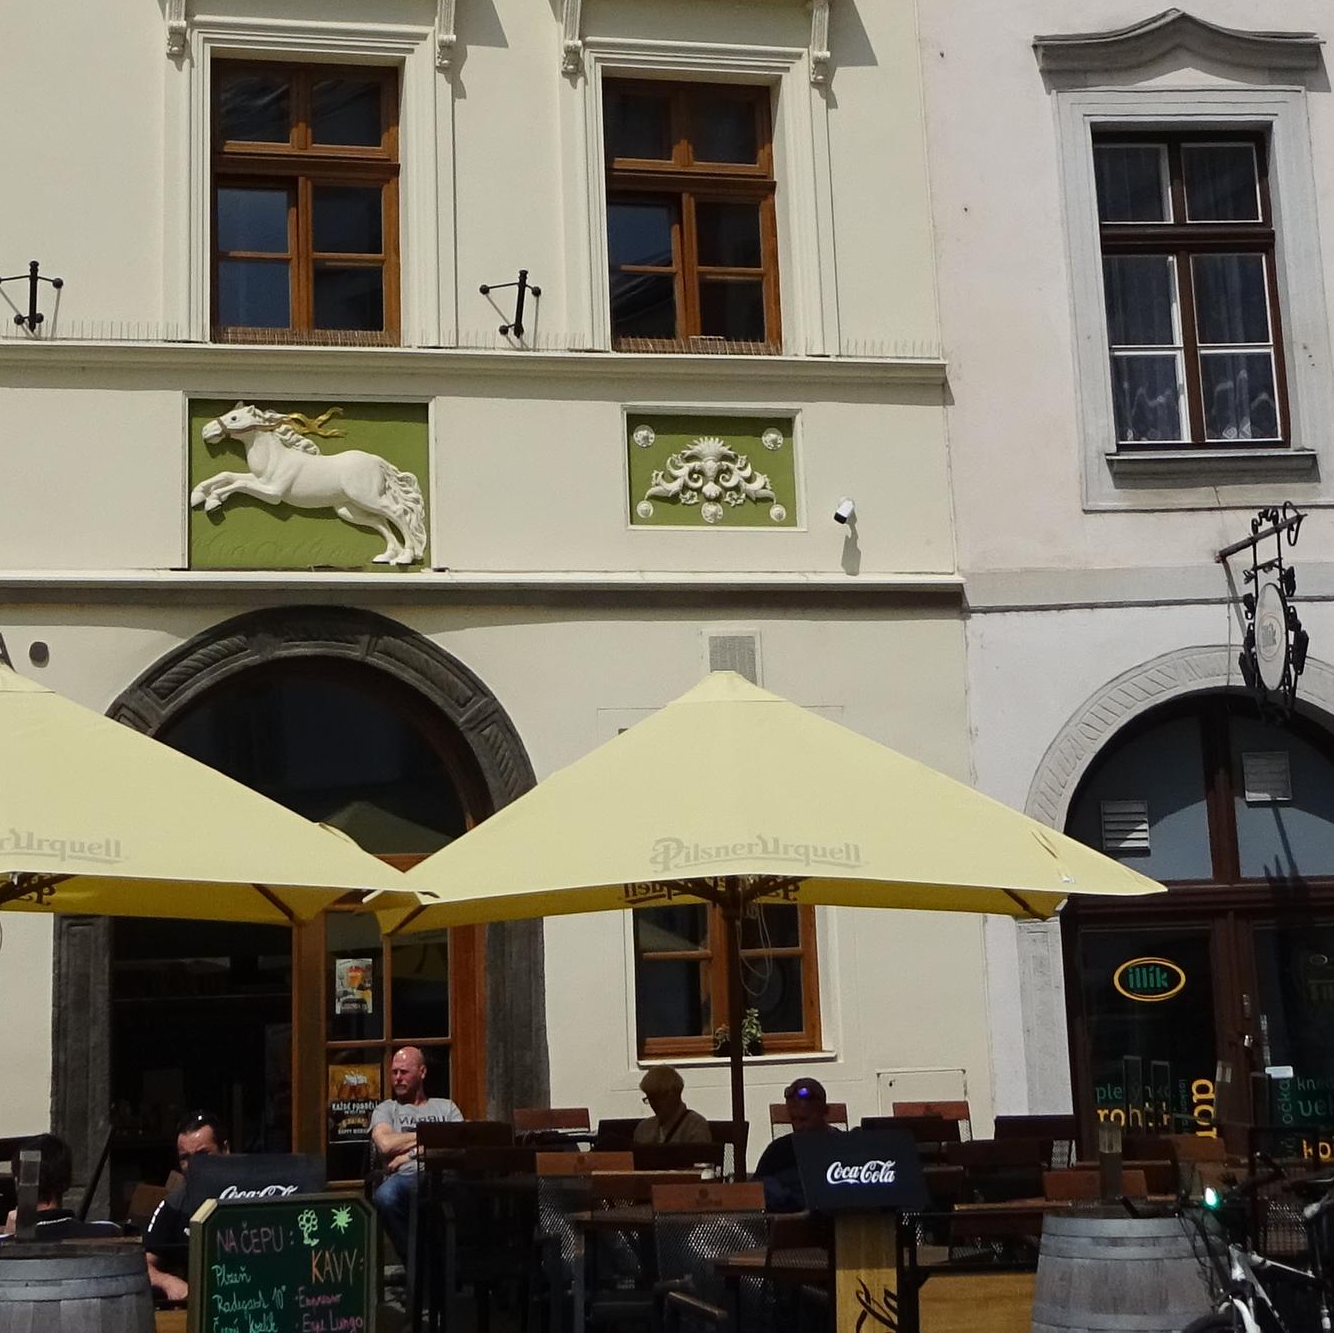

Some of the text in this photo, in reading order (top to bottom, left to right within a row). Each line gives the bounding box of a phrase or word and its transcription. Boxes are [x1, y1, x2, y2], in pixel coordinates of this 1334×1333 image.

[8, 828, 122, 862] Urquell
[649, 835, 861, 873] Pilsner Urquell
